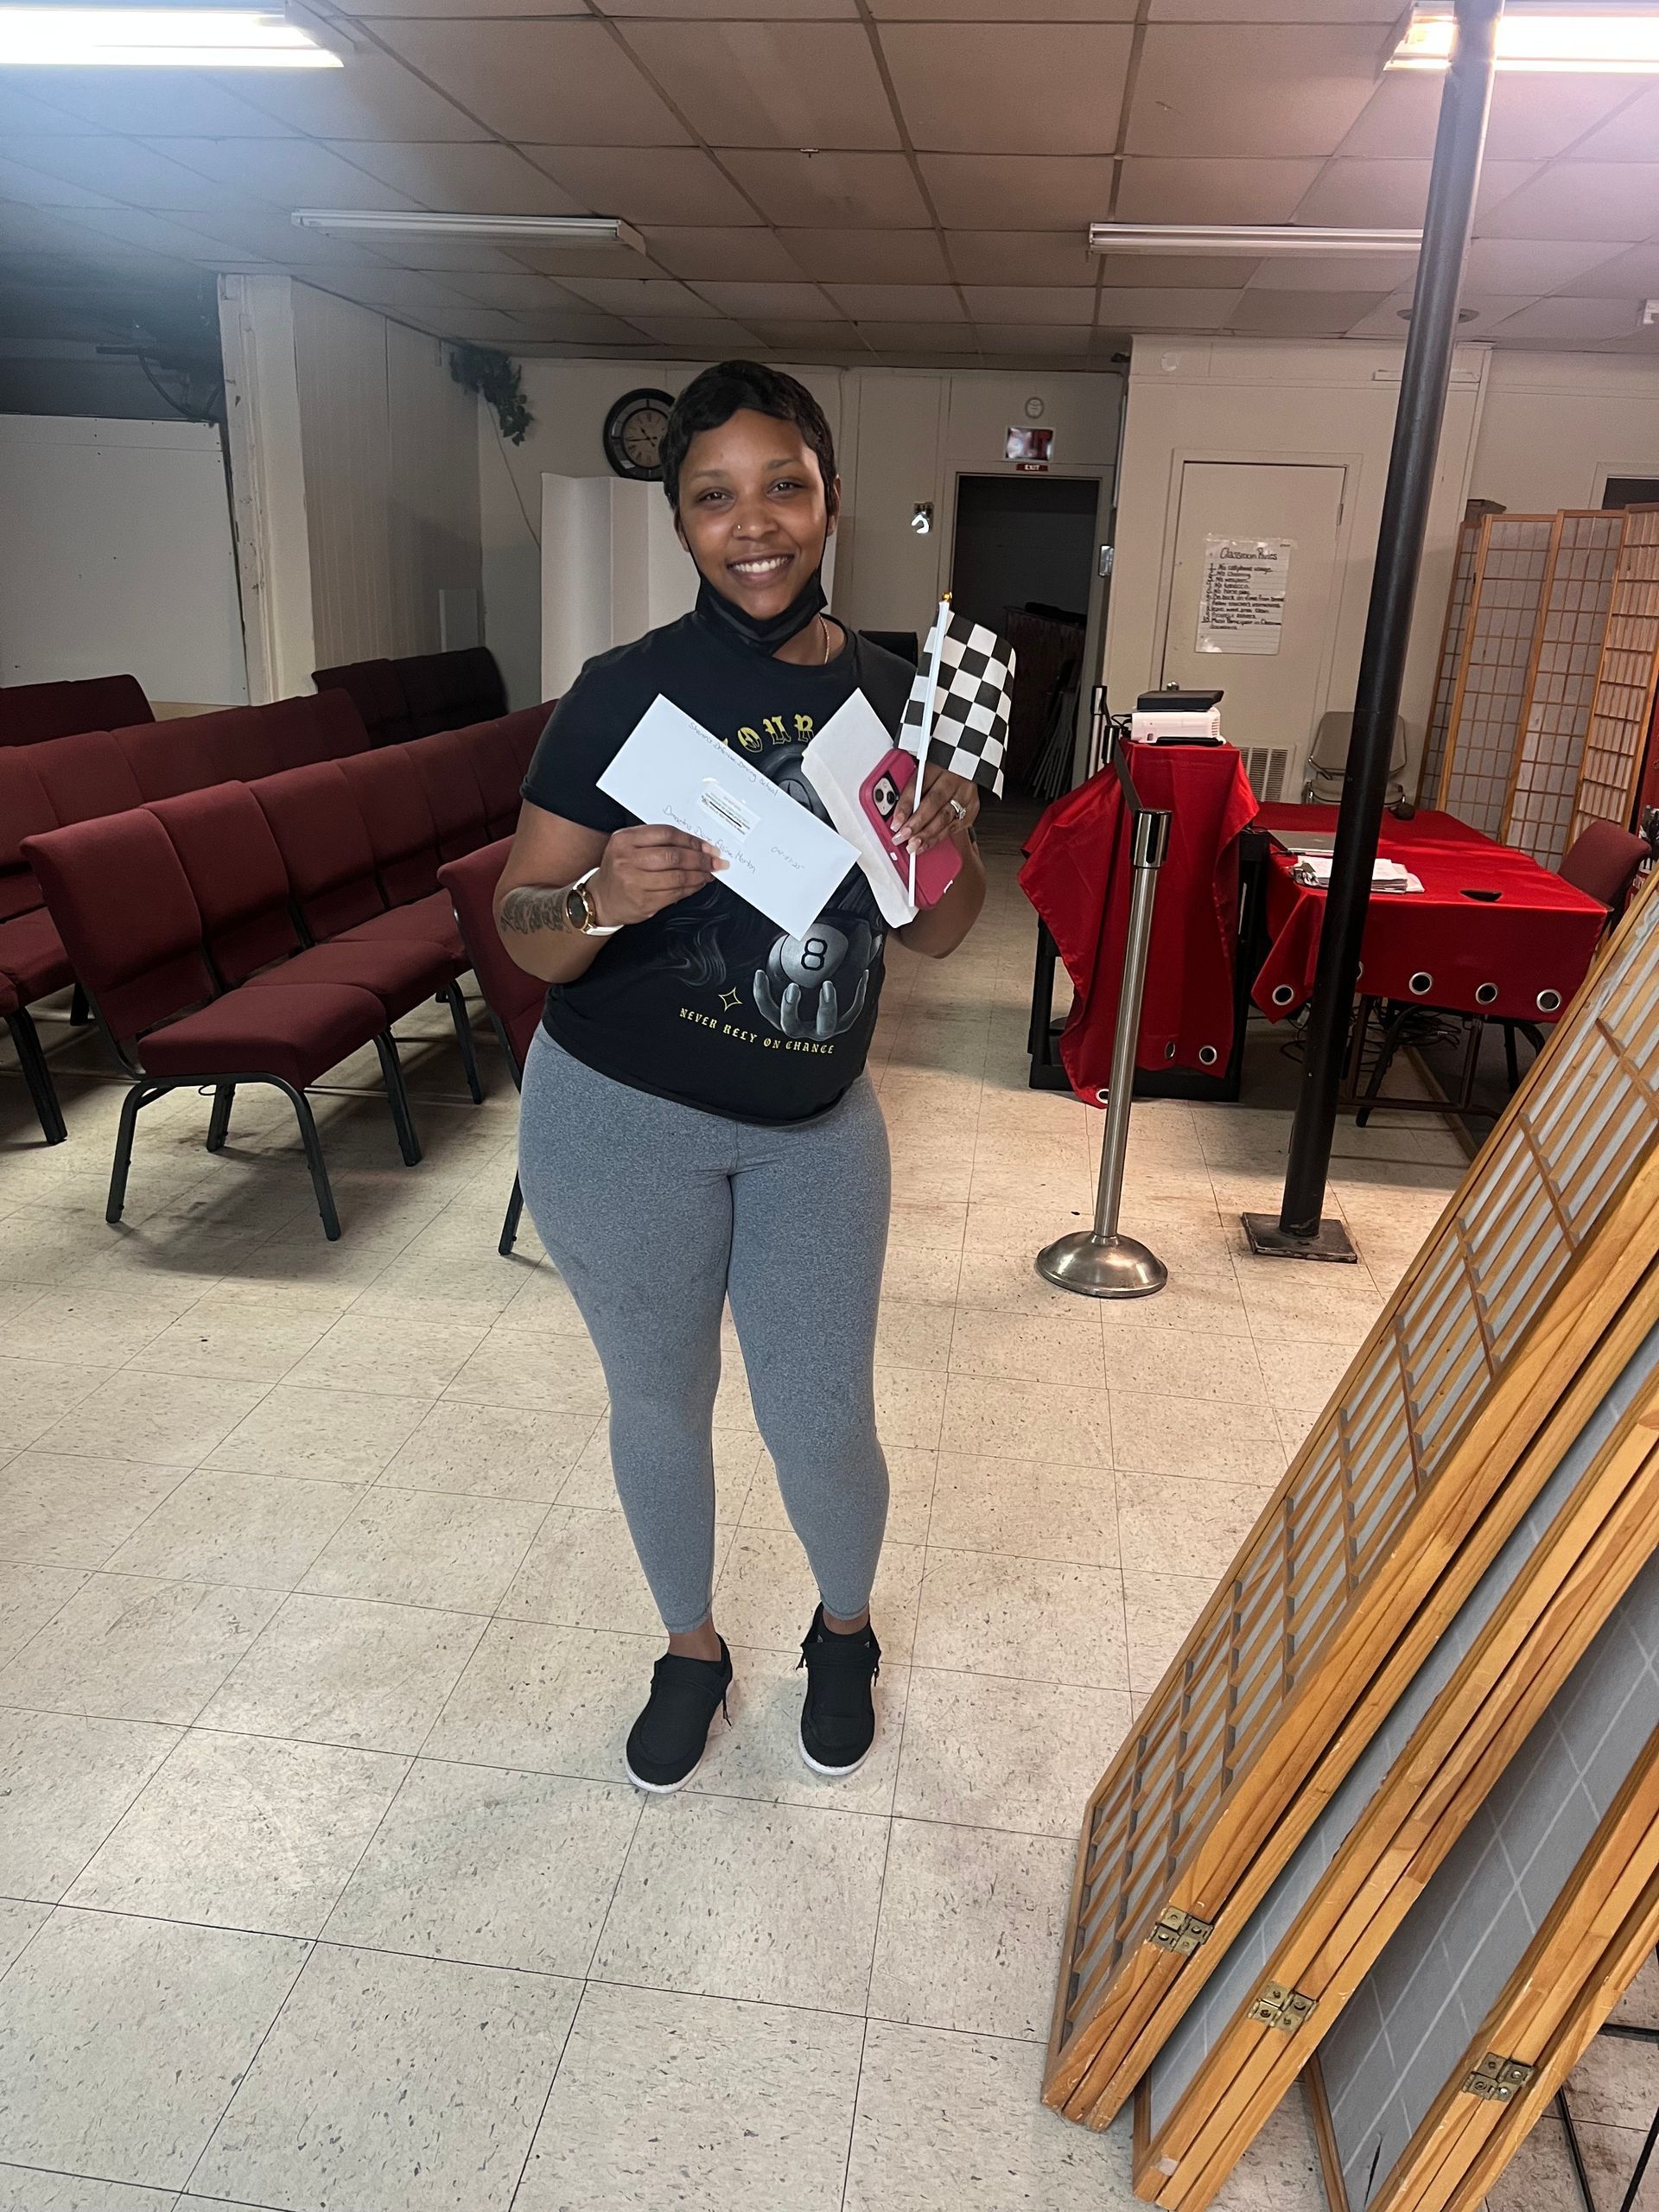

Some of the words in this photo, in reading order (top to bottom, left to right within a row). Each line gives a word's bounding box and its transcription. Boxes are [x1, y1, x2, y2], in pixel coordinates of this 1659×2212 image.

[1219, 547, 1256, 560] Classroom
[1257, 547, 1277, 561] Rules
[721, 713, 815, 753] OUR
[800, 938, 829, 971] 8
[679, 1007, 718, 1029] NEVER
[722, 1024, 758, 1044] RELY
[763, 1038, 781, 1049] ON
[785, 1040, 835, 1054] CHANCE
